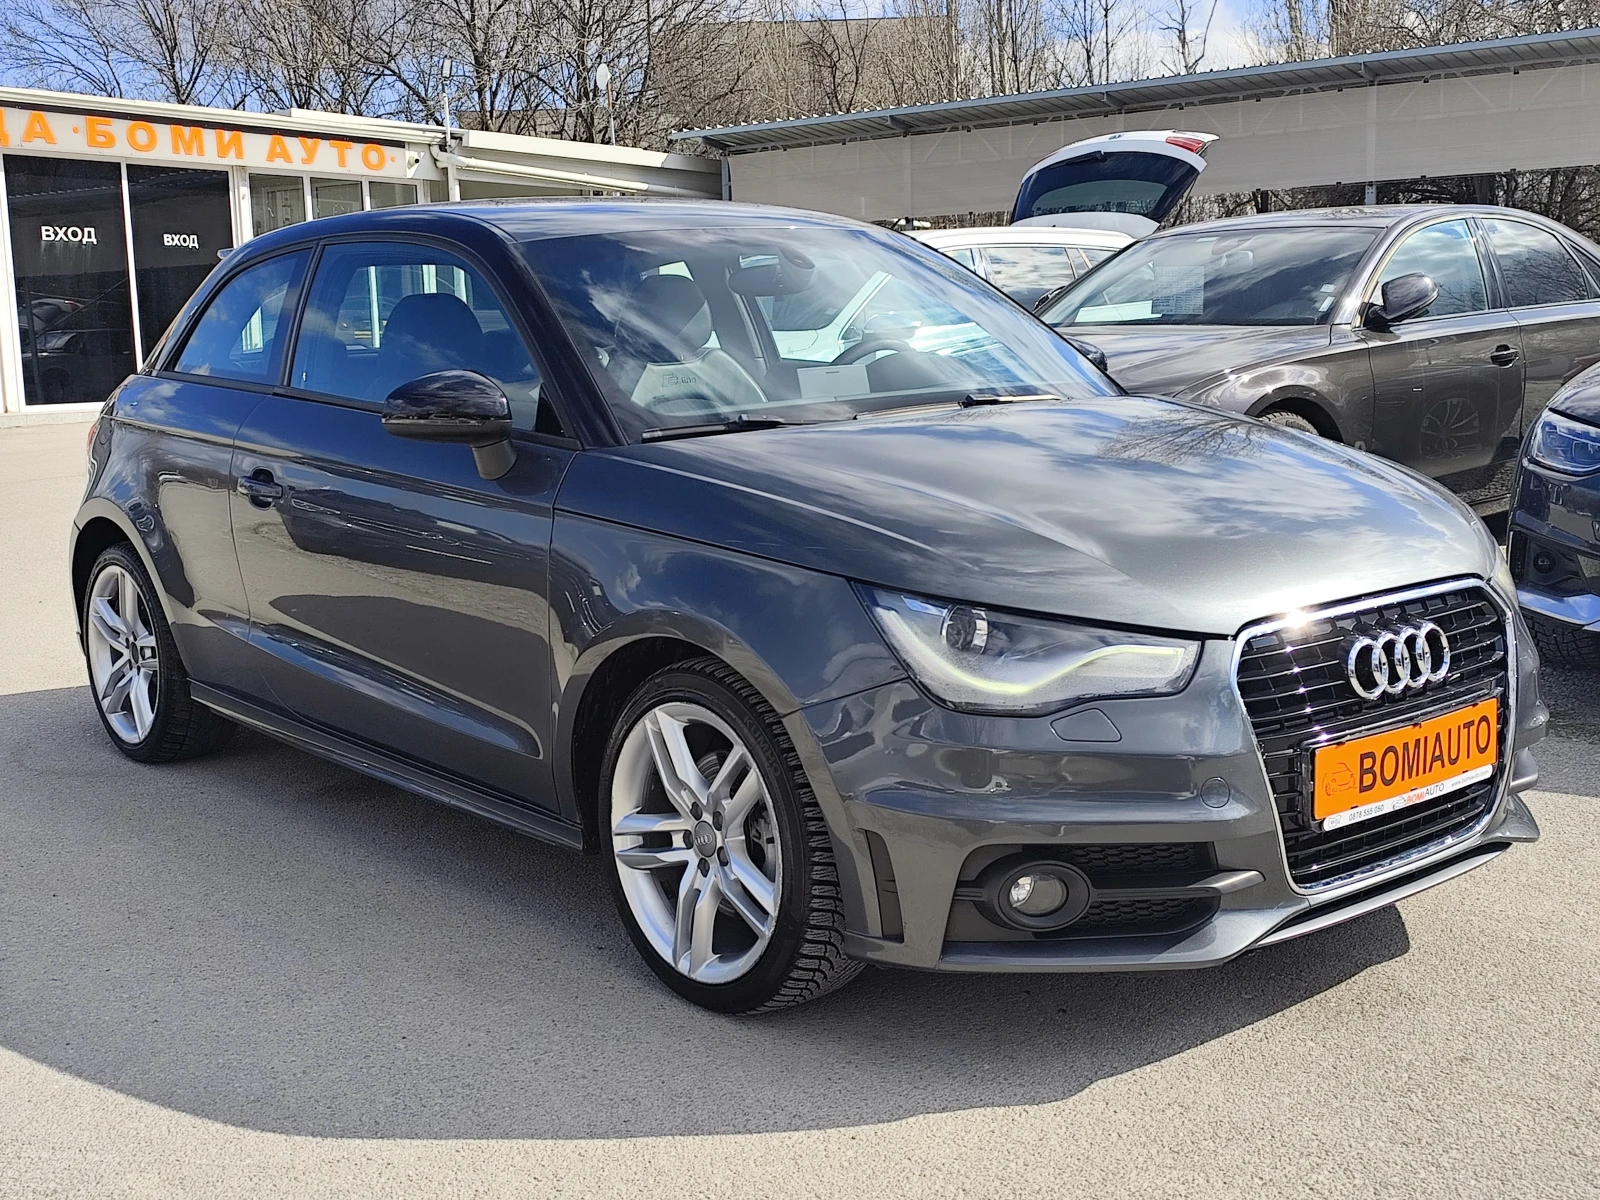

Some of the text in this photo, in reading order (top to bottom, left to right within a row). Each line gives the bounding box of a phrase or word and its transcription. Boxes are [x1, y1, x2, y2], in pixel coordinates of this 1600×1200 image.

[85, 115, 245, 160] БОМИ
[266, 134, 386, 171] АУТО
[41, 225, 97, 244] ВХОД
[163, 233, 199, 249] ВХОД
[743, 714, 781, 776] KUMHO
[1358, 715, 1491, 794] BOMIAUTO
